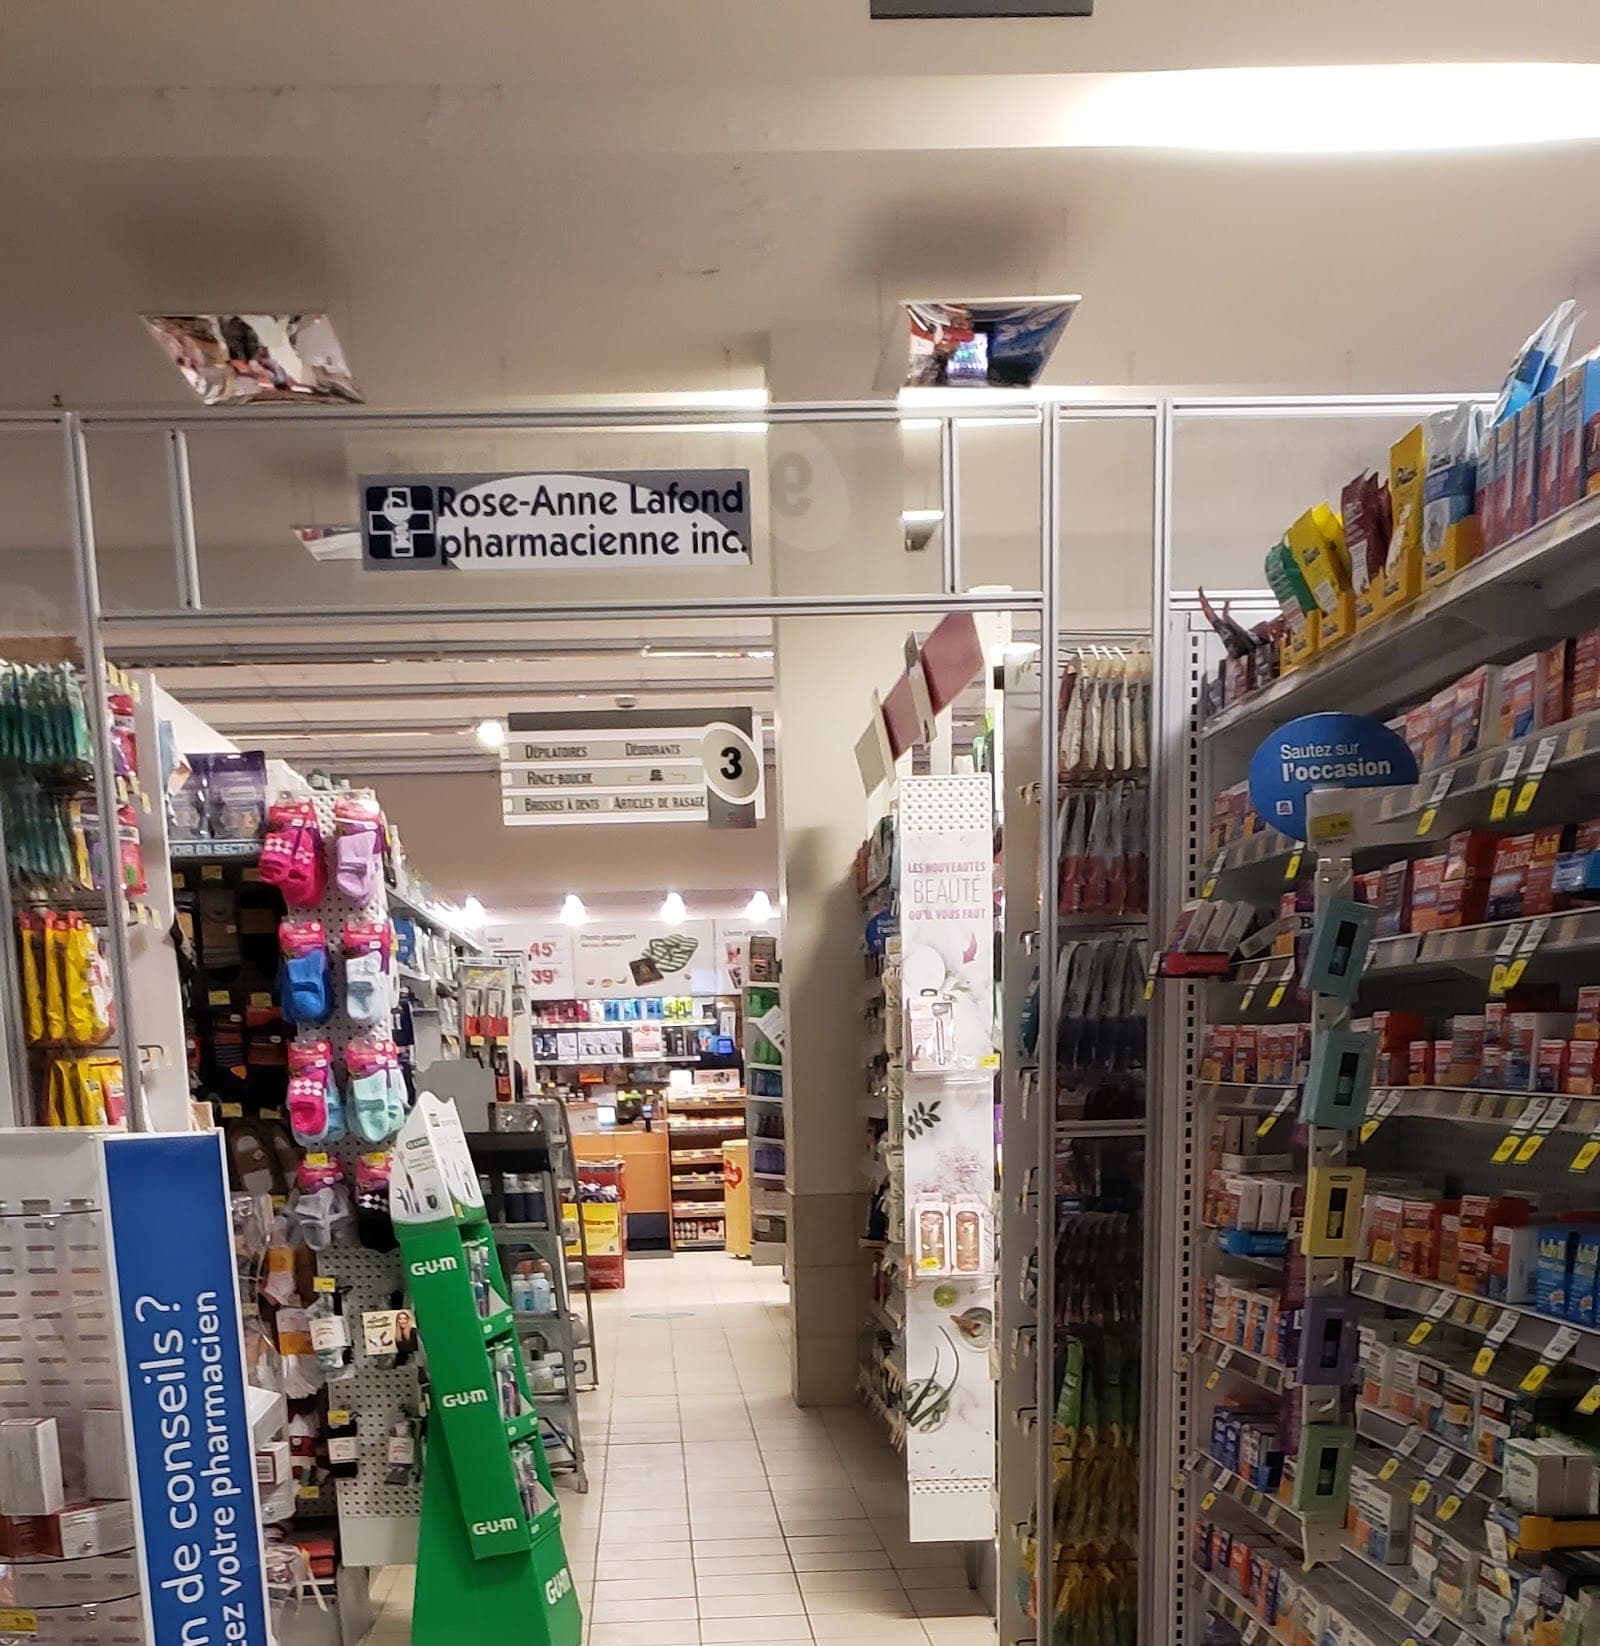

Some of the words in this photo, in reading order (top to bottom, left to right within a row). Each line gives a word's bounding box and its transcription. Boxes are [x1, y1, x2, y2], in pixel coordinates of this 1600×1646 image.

[437, 483, 618, 518] Rose-Anne
[630, 481, 744, 515] Lafond
[439, 523, 681, 566] pharmacienne
[691, 521, 749, 555] inc.
[719, 746, 743, 780] 3
[1280, 742, 1332, 760] Sautez
[1336, 742, 1361, 756] sur
[1282, 757, 1392, 783] l'occasion
[214, 842, 261, 855] SECTIO
[191, 1291, 242, 1497] pharmacien
[139, 1328, 198, 1530] conseils
[209, 1506, 242, 1596] votre
[161, 1543, 205, 1604] de
